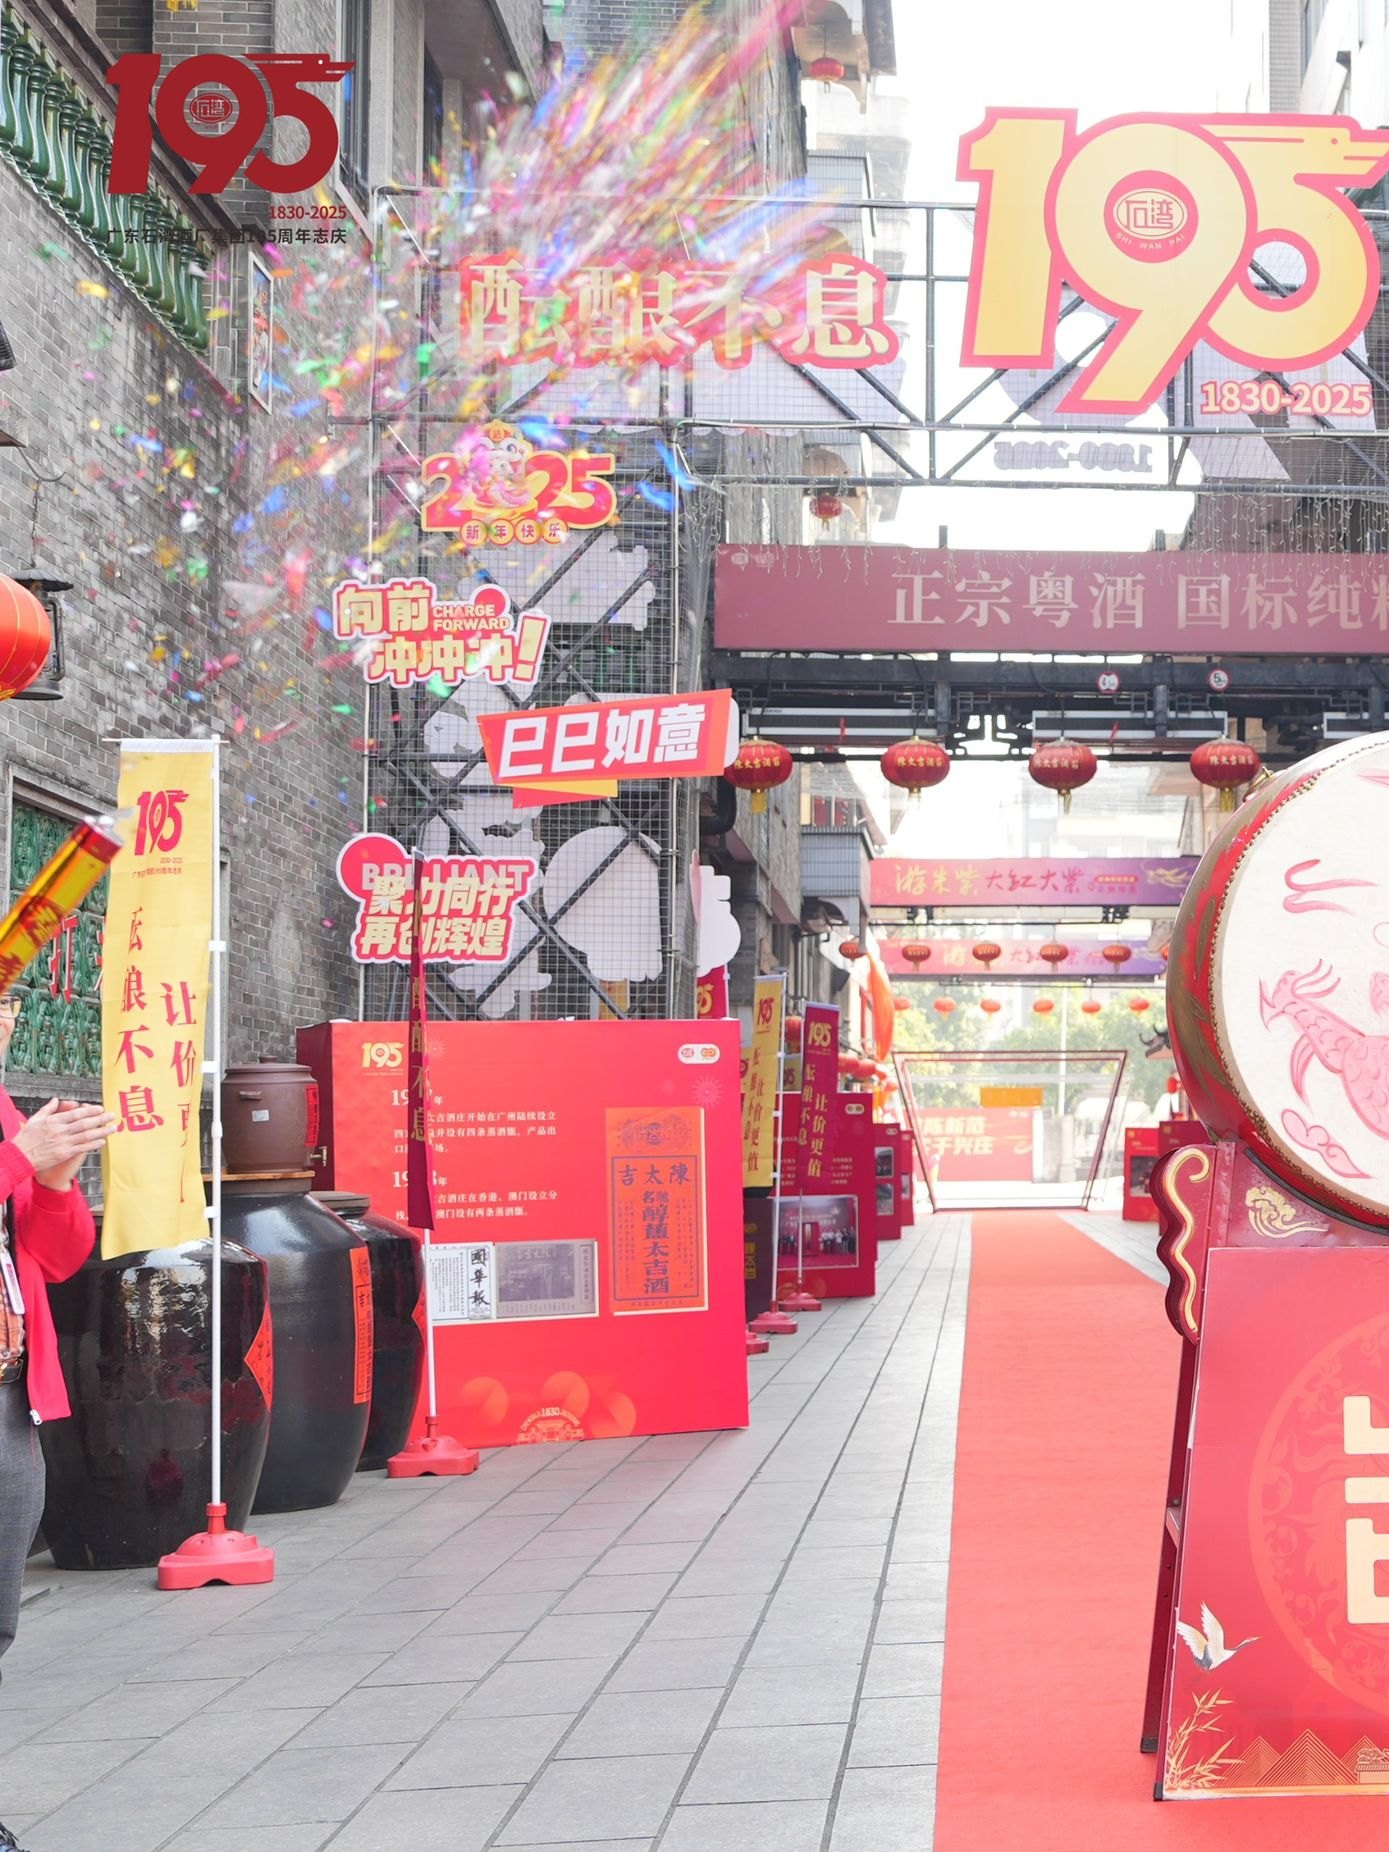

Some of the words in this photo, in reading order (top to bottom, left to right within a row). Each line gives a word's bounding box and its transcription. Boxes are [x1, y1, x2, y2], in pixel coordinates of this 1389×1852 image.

[469, 259, 891, 358] 酝酿不息
[1202, 383, 1371, 414] 1830-2025
[425, 453, 611, 528] 225
[464, 524, 563, 540] 新年快乐
[338, 584, 429, 636] 向前
[432, 604, 496, 618] CHARGE
[887, 570, 1147, 629] 正宗粤酒
[433, 617, 510, 631] FORWARD
[367, 875, 516, 917] 聚力同行
[360, 915, 508, 957] 再创辉煌
[361, 1042, 405, 1068] 195
[808, 1021, 833, 1047] 195
[808, 1093, 828, 1177] 让价更值
